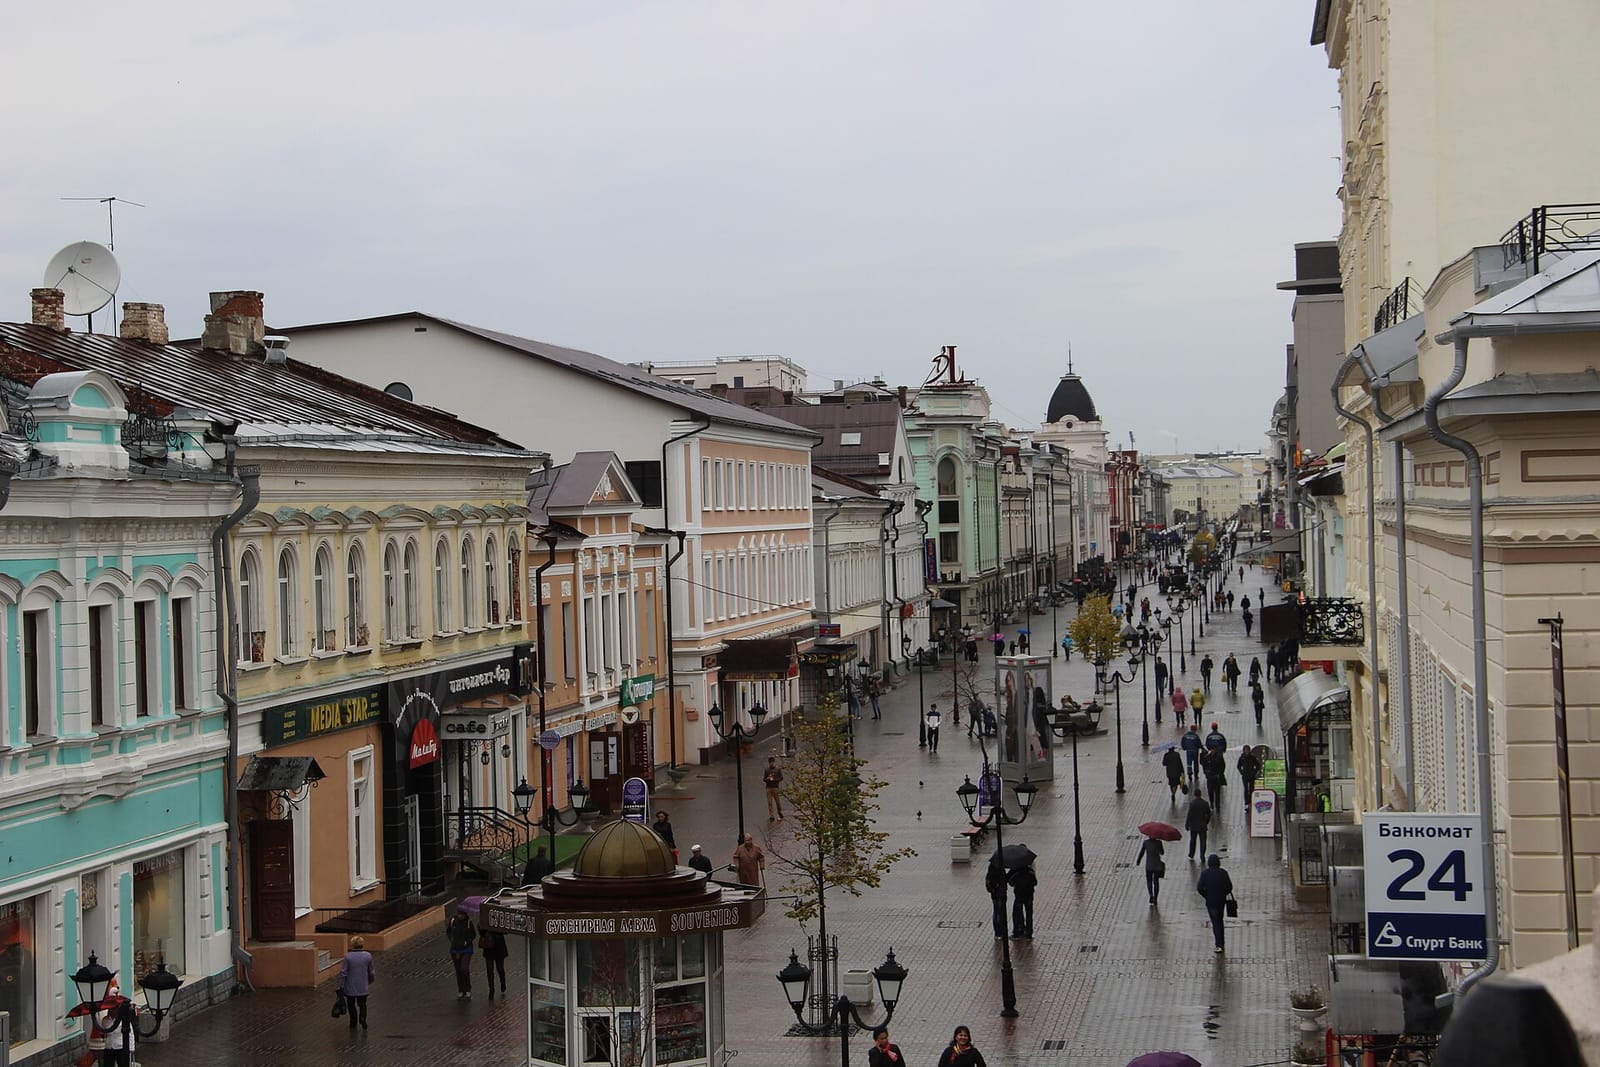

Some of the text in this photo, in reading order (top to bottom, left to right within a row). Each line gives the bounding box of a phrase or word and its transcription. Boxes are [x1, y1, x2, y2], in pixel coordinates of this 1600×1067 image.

[310, 703, 341, 732] MEDIA
[346, 697, 368, 724] STAR
[446, 720, 487, 733] cafe
[1379, 823, 1473, 838] Банкомат
[1386, 849, 1473, 901] 24
[489, 908, 536, 934] СУВЕНРЫ
[546, 917, 657, 935] СУВЕНИРНАЯ ЛАВКА
[670, 906, 740, 933] SOUVENIRS
[1406, 936, 1483, 951] Спурт Банк
